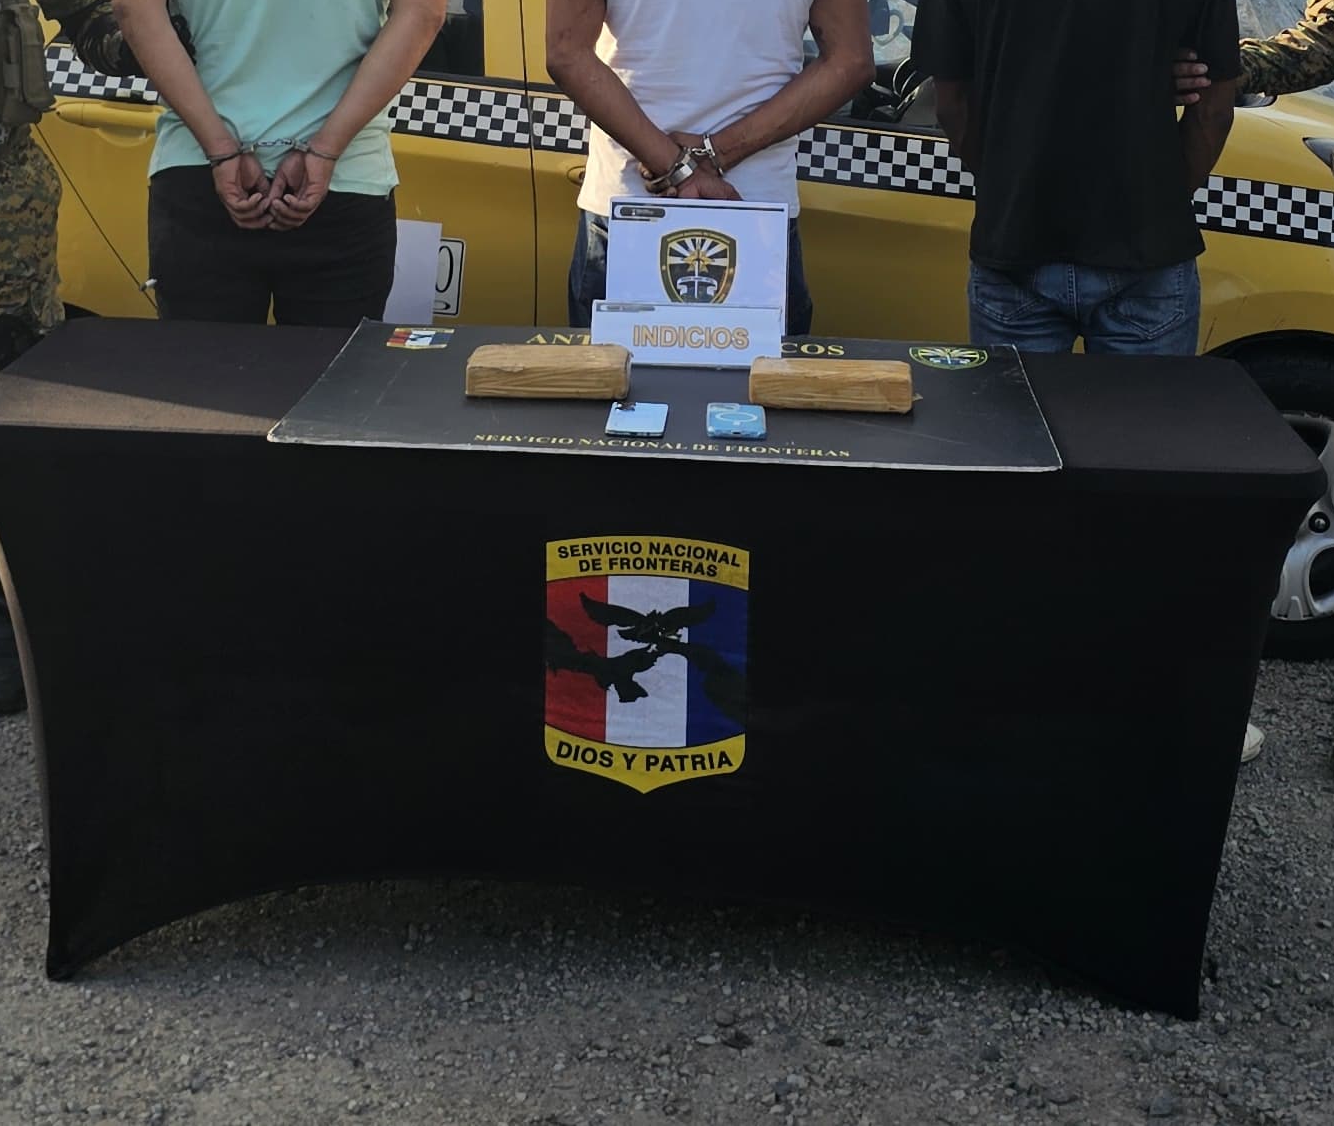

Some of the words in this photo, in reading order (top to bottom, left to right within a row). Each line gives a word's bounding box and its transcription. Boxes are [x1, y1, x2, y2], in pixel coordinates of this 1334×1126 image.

[633, 324, 750, 350] INDICIOS
[474, 433, 574, 445] SERVICIO
[578, 437, 688, 451] NACIONAL
[692, 443, 718, 452] DE
[725, 444, 850, 458] FRONTERAS
[557, 541, 643, 559] SERVICIO
[649, 542, 742, 568] NACIONAL
[578, 558, 603, 573] DE
[608, 557, 718, 578] FRONTERAS
[556, 740, 614, 768] DIOS
[622, 752, 637, 771] Y
[645, 750, 734, 773] PATRIA
